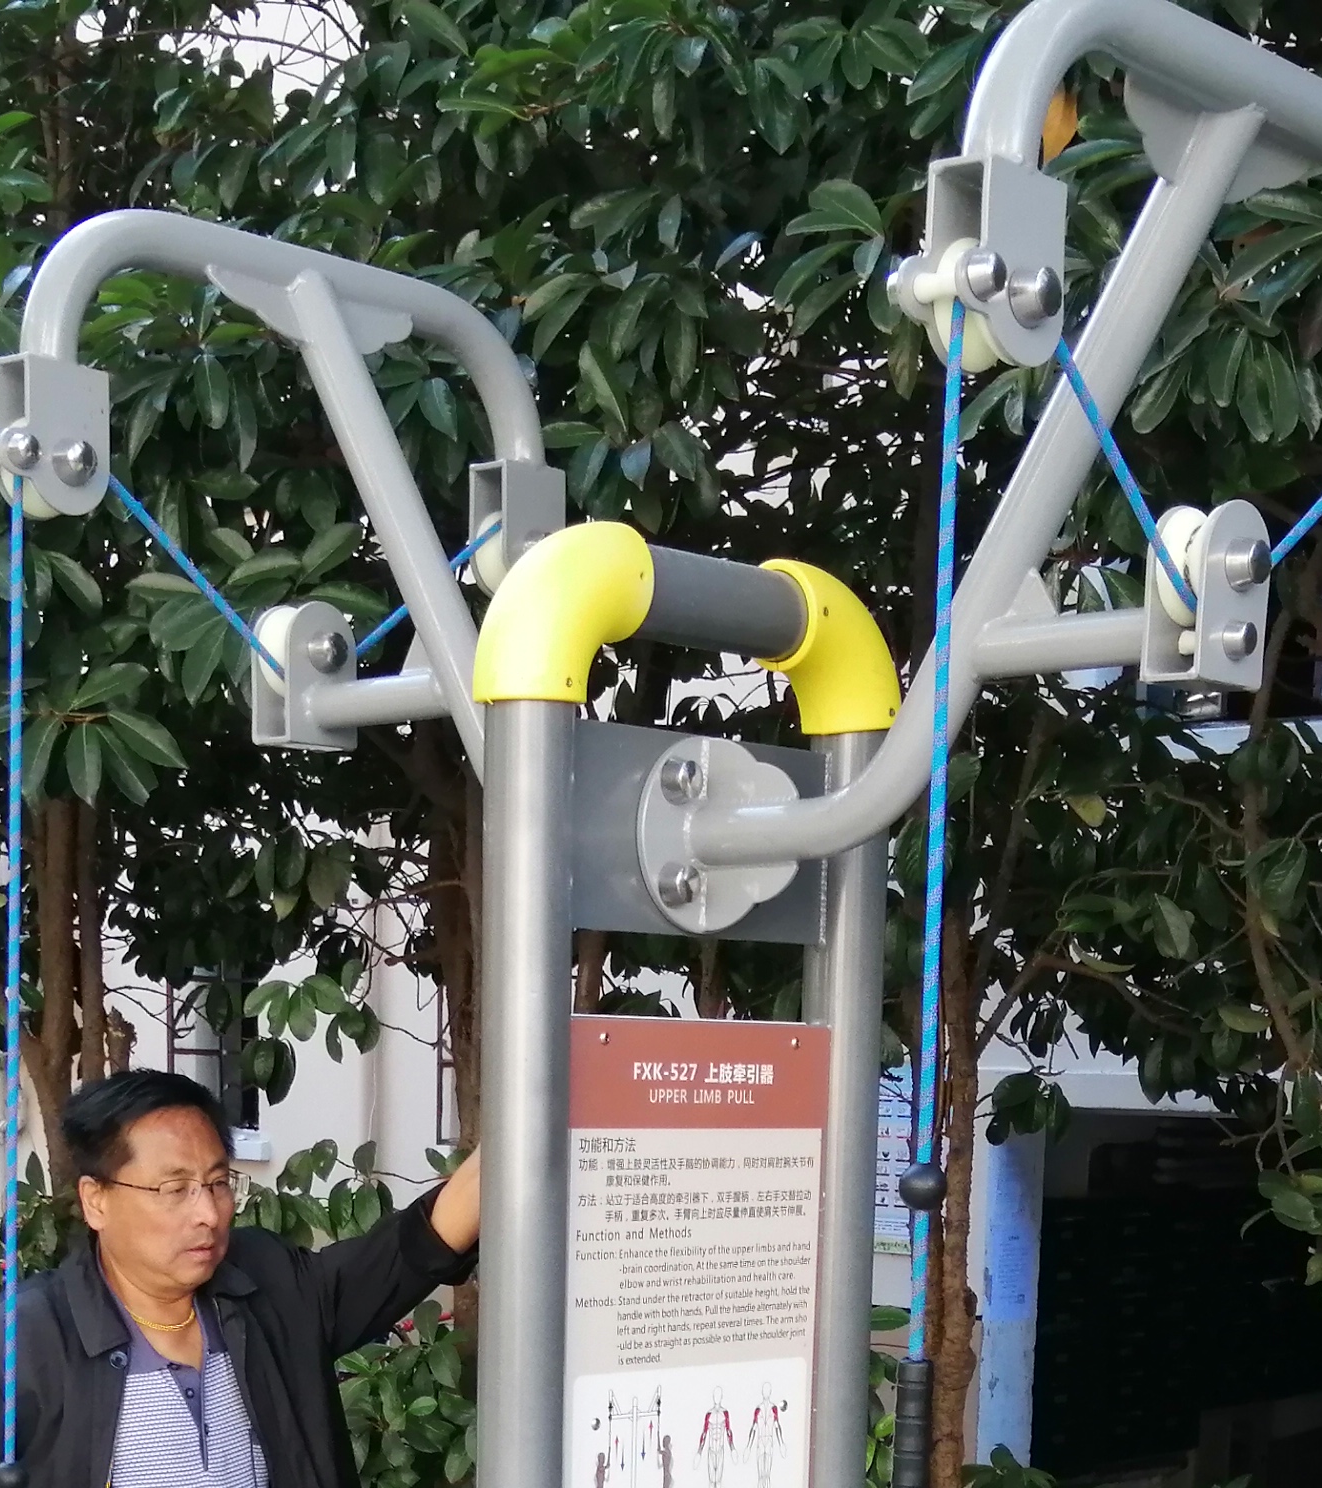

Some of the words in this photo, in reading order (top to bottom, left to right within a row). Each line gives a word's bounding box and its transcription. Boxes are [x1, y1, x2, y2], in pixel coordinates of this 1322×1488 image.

[633, 1061, 697, 1081] FXK-527
[704, 1061, 774, 1085] 上肢牵引器
[649, 1088, 688, 1103] UPPER
[693, 1088, 722, 1104] LIMB
[727, 1089, 755, 1104] PULL
[579, 1136, 636, 1153] 功能和方法
[576, 1228, 620, 1242] Function
[625, 1227, 643, 1240] and
[649, 1225, 691, 1239] Methods
[618, 1247, 653, 1259] Enhance
[654, 1246, 668, 1258] the
[669, 1244, 707, 1259] flexibility
[707, 1244, 716, 1255] of
[717, 1244, 730, 1255] the
[731, 1245, 754, 1256] upper
[755, 1242, 776, 1253] limbs
[776, 1241, 791, 1252] and
[792, 1240, 810, 1251] hand
[695, 1260, 704, 1271] At
[705, 1259, 718, 1270] the
[719, 1260, 738, 1269] same
[756, 1259, 766, 1267] on
[766, 1257, 779, 1267] the
[779, 1254, 810, 1266] shoulder
[619, 1277, 644, 1290] elbow
[645, 1276, 661, 1288] and
[662, 1277, 682, 1287] wrist
[683, 1272, 736, 1286] rehabilitation
[737, 1272, 751, 1282] and
[753, 1270, 776, 1282] health
[617, 1294, 640, 1306] Stand
[642, 1293, 665, 1304] under
[666, 1292, 680, 1303] the
[681, 1291, 714, 1302] retractor
[715, 1289, 723, 1300] of
[724, 1287, 753, 1300] suitable
[781, 1284, 797, 1296] hold
[798, 1284, 810, 1295] the
[617, 1309, 642, 1321] handle
[643, 1308, 660, 1319] with
[661, 1307, 679, 1318] both
[704, 1304, 718, 1315] Pull
[719, 1304, 731, 1314] the
[756, 1299, 792, 1313] alternately
[616, 1324, 630, 1336] left
[631, 1323, 646, 1335] and
[647, 1322, 665, 1336] right
[692, 1320, 716, 1332] repeat
[717, 1317, 742, 1329] several
[765, 1314, 779, 1325] The
[779, 1315, 793, 1324] arm
[633, 1338, 643, 1349] be
[644, 1340, 653, 1349] as
[653, 1336, 682, 1350] straight
[682, 1337, 691, 1346] as
[692, 1333, 721, 1347] possible
[731, 1331, 746, 1342] that
[746, 1330, 758, 1341] the
[759, 1327, 789, 1340] shoulder
[617, 1354, 624, 1366] is
